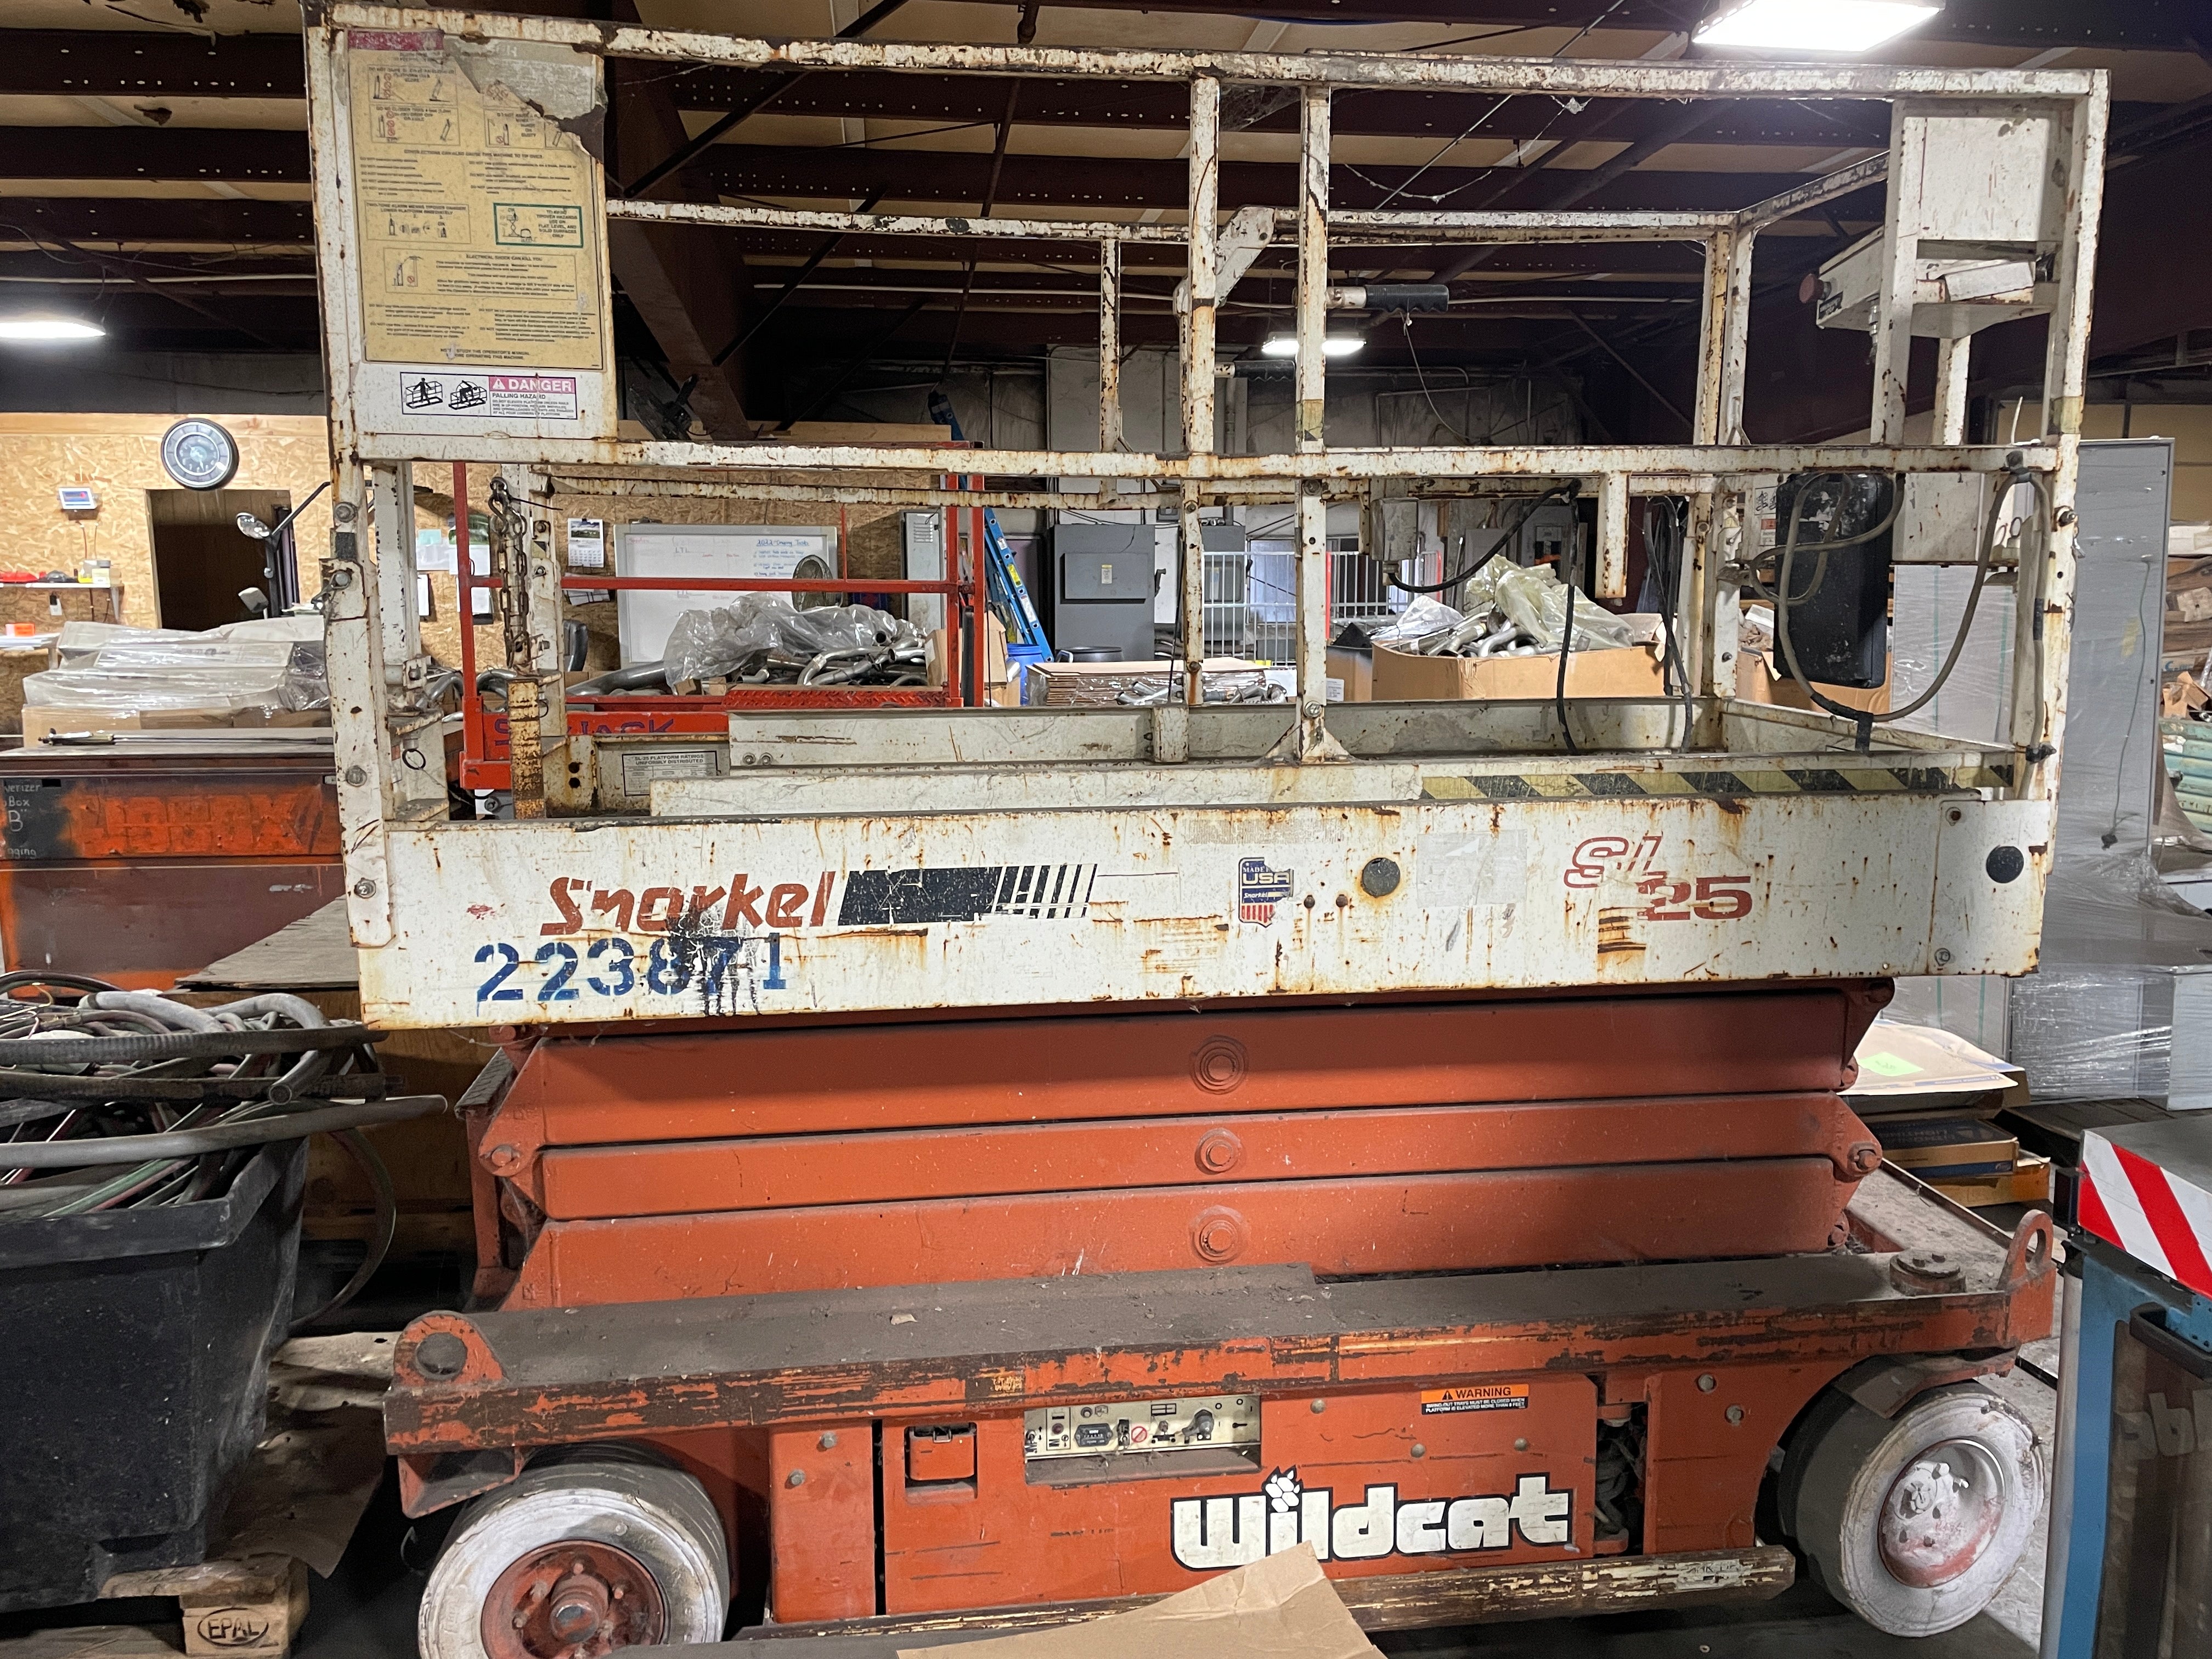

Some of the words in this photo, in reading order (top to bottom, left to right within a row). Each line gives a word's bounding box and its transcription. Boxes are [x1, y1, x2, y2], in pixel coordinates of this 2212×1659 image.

[508, 379, 572, 392] DANGER
[1243, 872, 1290, 884] USA
[540, 871, 836, 936] Snorkel
[1637, 876, 1752, 922] 25
[475, 932, 787, 1002] 223871
[1454, 1387, 1511, 1399] WARNING
[208, 1617, 260, 1639] EPAL
